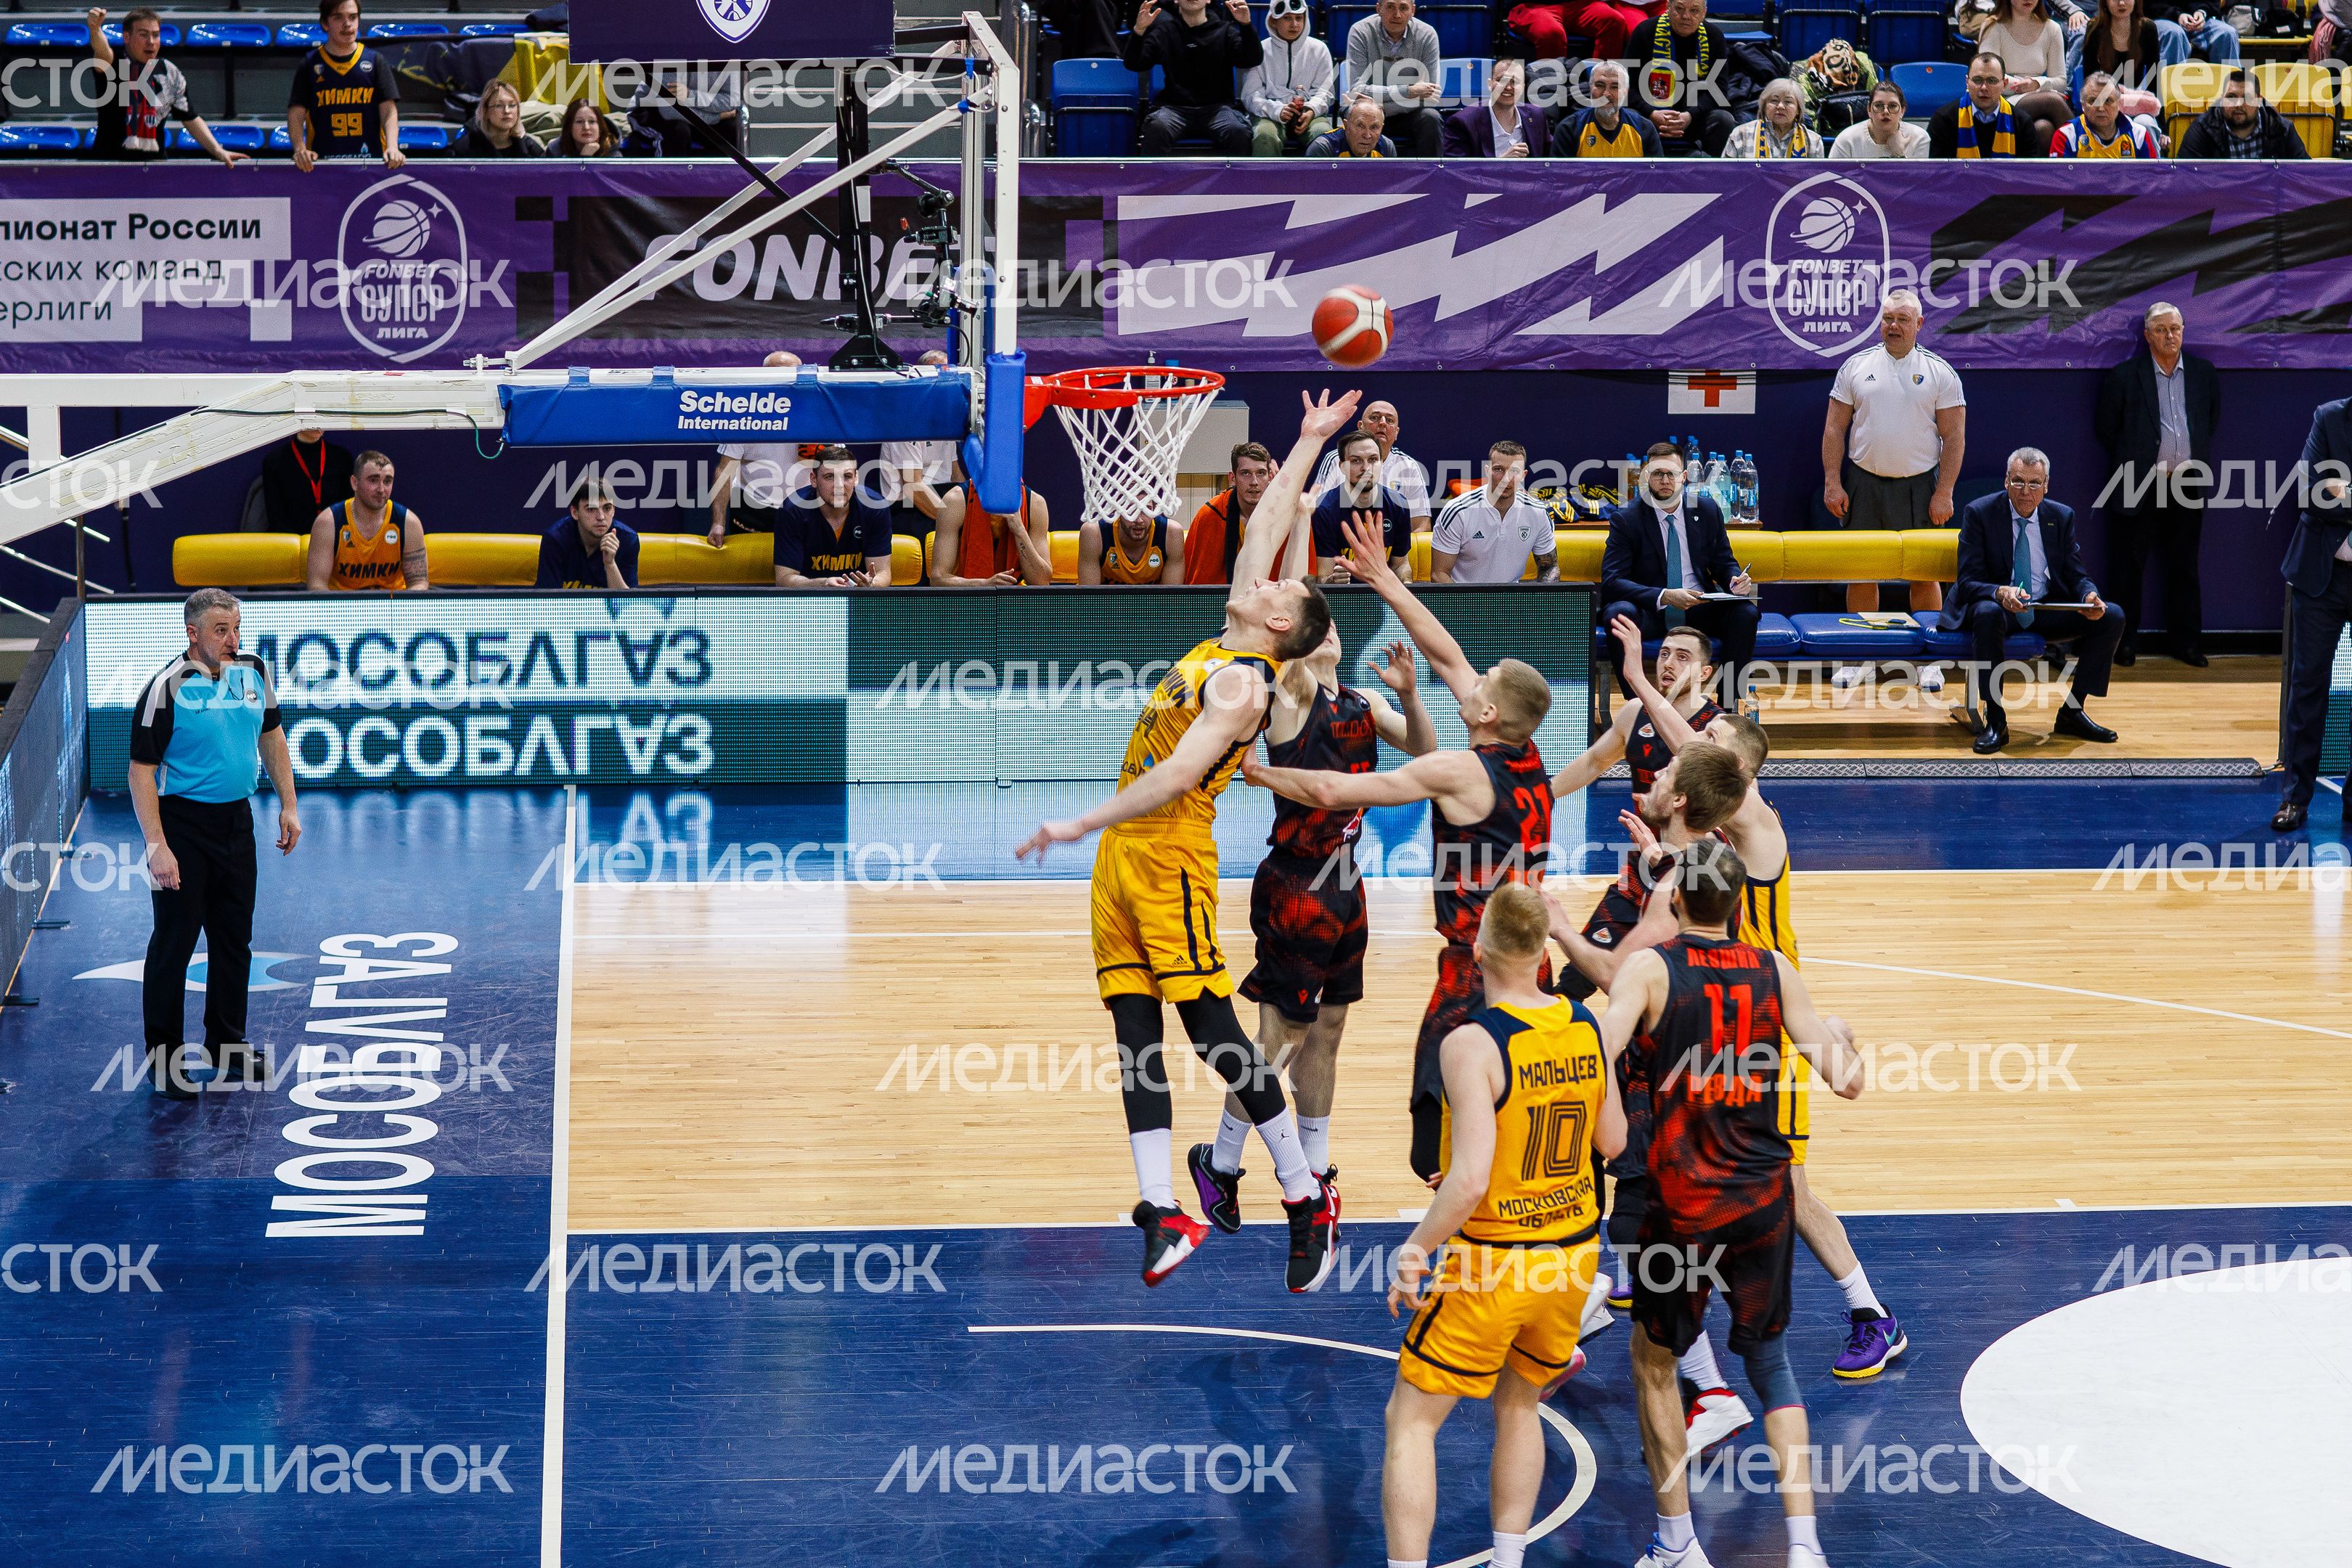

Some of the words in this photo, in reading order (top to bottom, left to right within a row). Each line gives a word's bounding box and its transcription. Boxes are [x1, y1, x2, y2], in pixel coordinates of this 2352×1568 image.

[316, 86, 375, 107] ХИМКИ
[331, 112, 363, 137] 99
[128, 213, 261, 240] России
[0, 260, 82, 281] ских
[96, 260, 226, 285] команд
[364, 264, 441, 279] FONBET
[640, 234, 997, 301] FONBE
[1790, 259, 1864, 274] FONBET
[376, 327, 429, 339] ЛИГА
[1802, 322, 1853, 333] ЛИГА
[679, 391, 791, 414] Schelde
[677, 415, 789, 430] International
[339, 560, 400, 579] ХИМКИ
[811, 552, 863, 571] ХИМКИ
[260, 714, 714, 777] ОСОБЛГАЗ
[1512, 783, 1551, 852] 21
[1703, 984, 1753, 1057] 11
[265, 932, 459, 1237] МОСОБЛГАЗ
[1519, 1055, 1597, 1090] МАЛЬЦЕВ
[1522, 1101, 1588, 1182] 10
